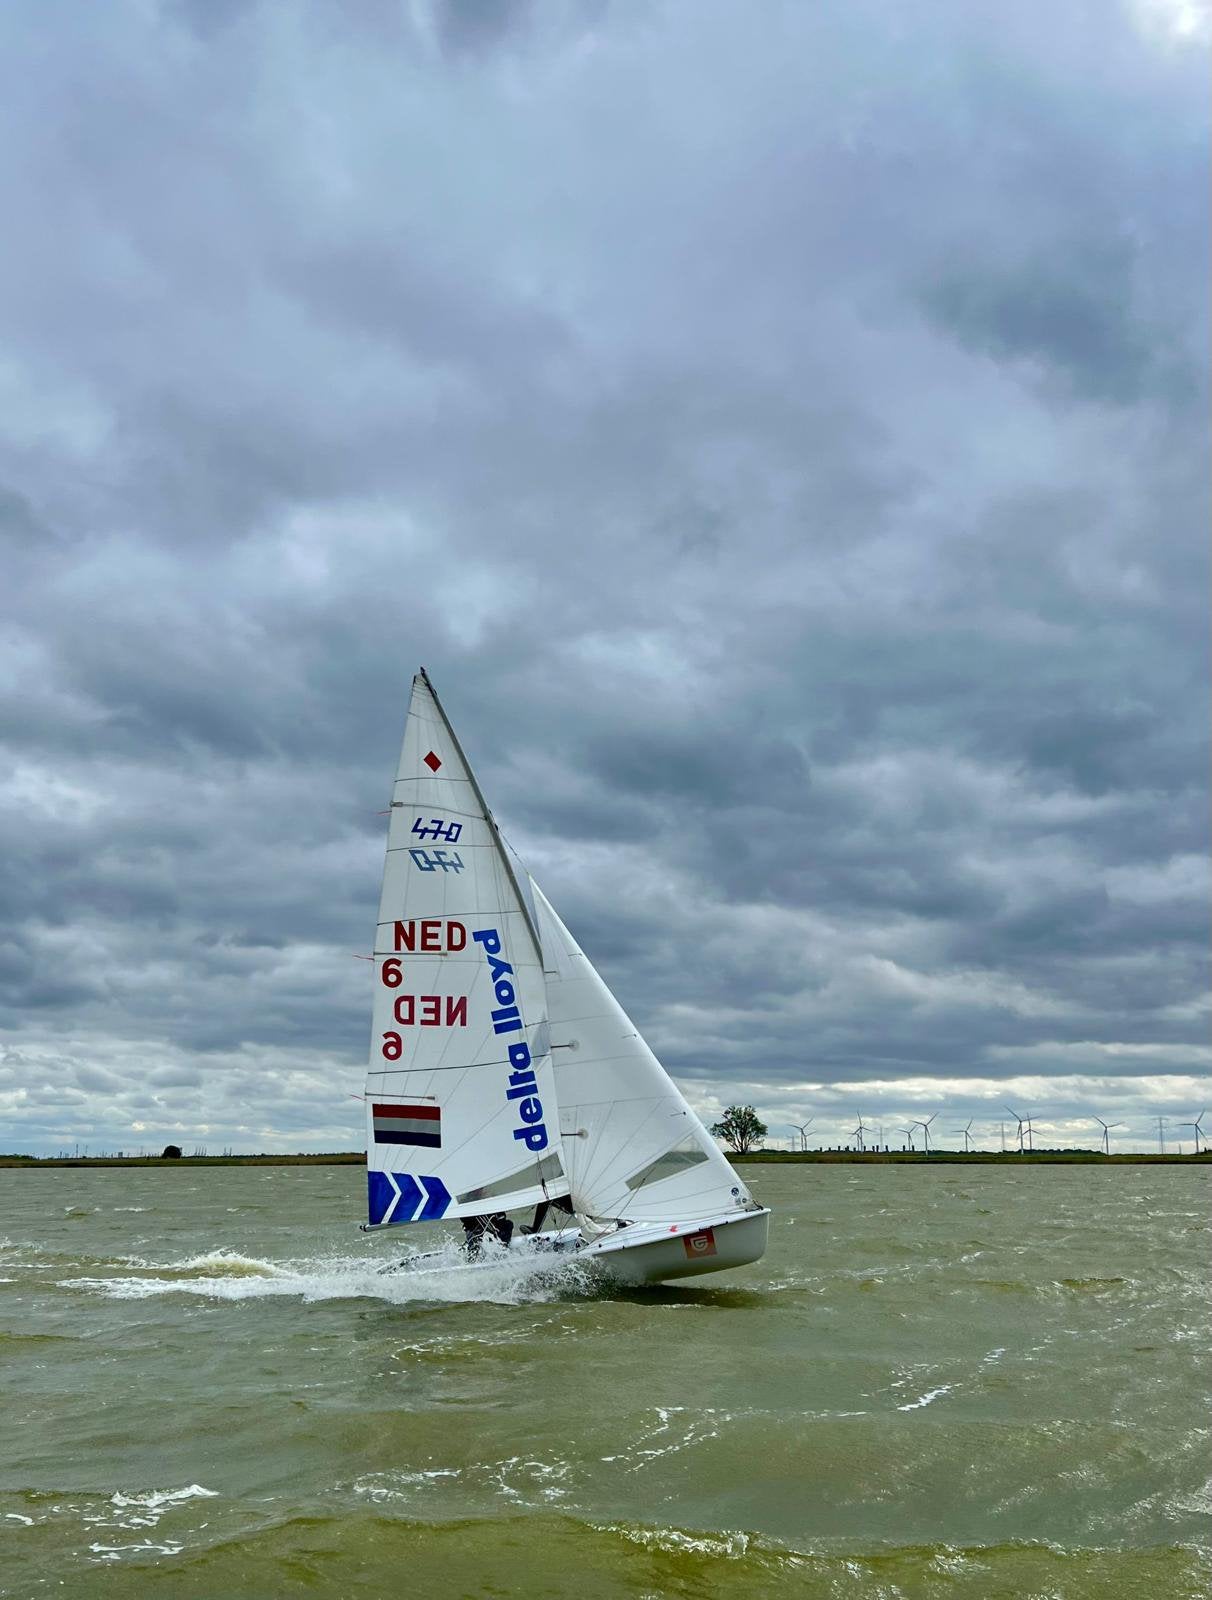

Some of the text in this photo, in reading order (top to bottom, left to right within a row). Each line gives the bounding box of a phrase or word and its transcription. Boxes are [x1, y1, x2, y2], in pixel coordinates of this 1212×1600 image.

[411, 817, 463, 843] 470
[394, 920, 467, 952] NED
[381, 958, 403, 988] 6
[472, 928, 549, 1152] delta lloyd
